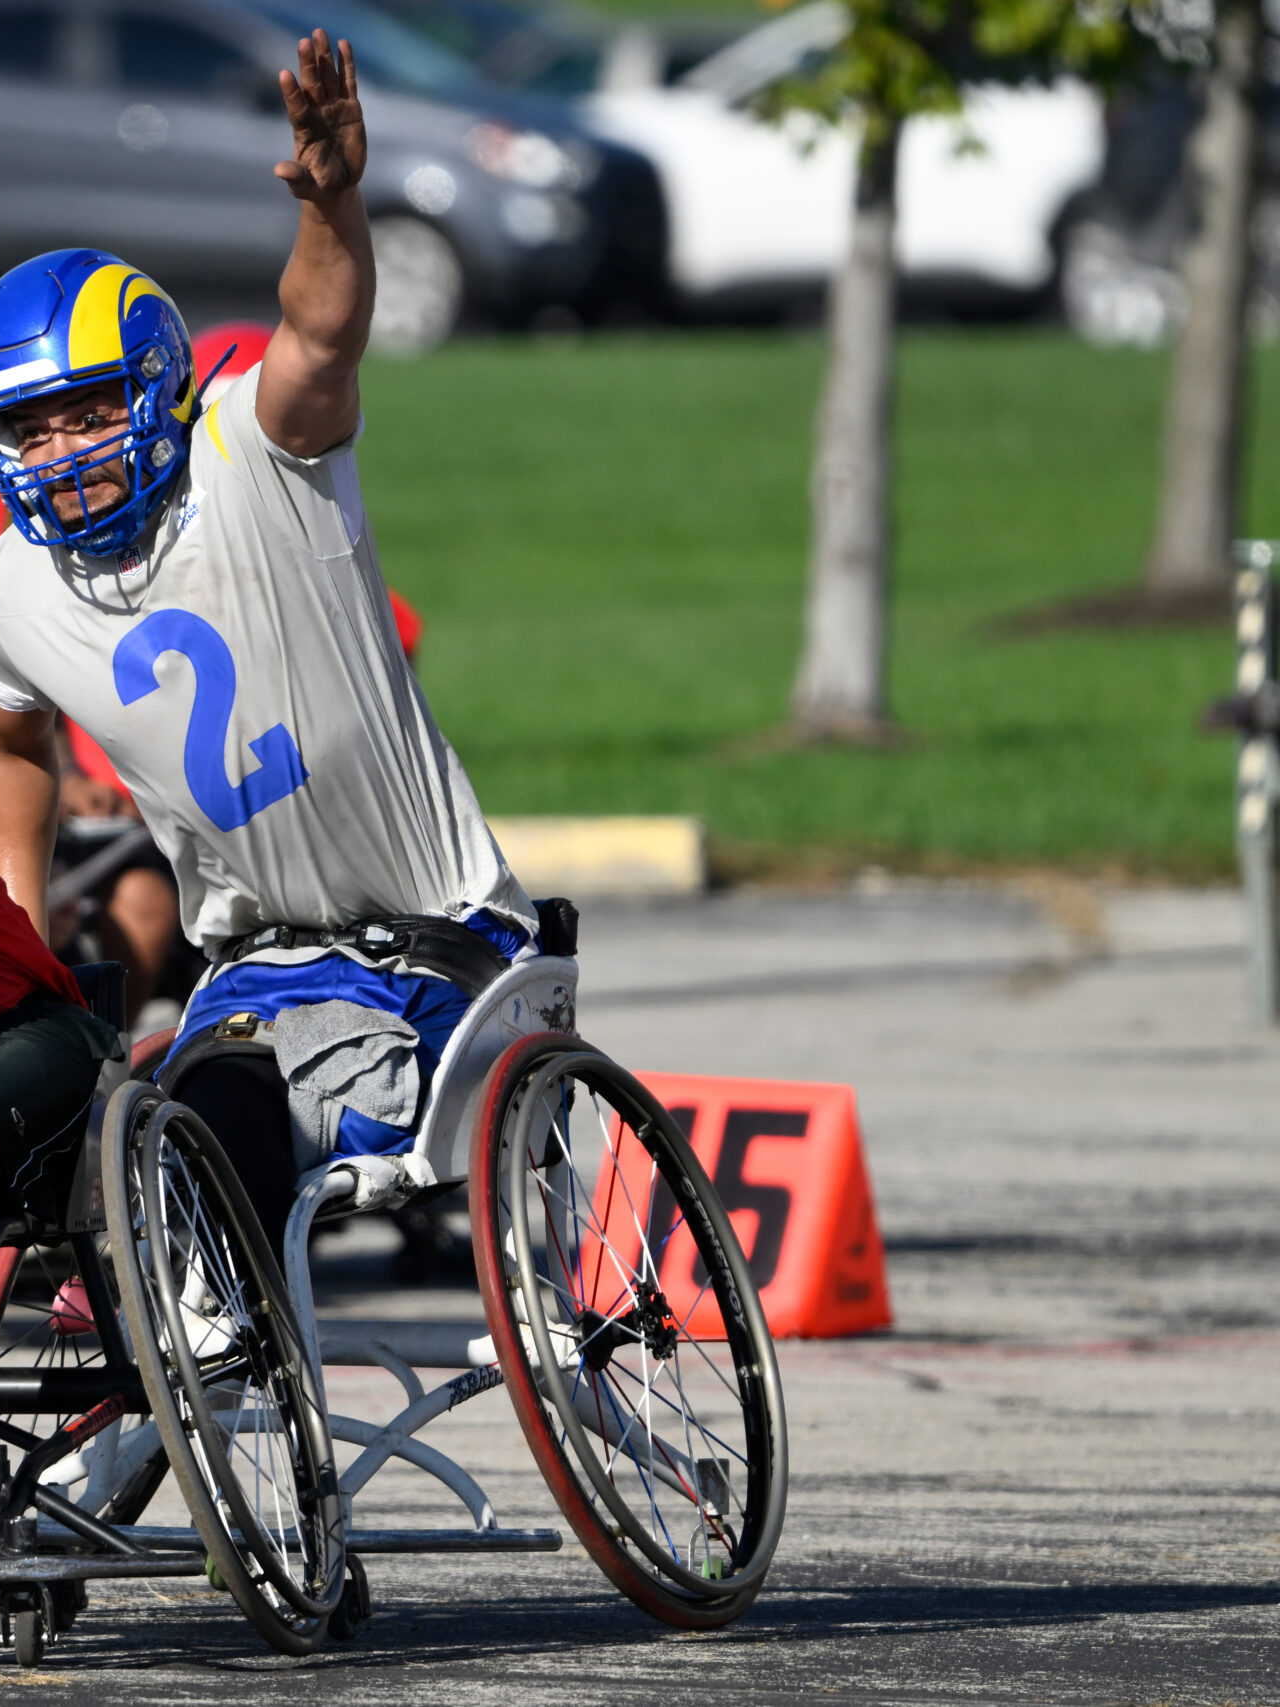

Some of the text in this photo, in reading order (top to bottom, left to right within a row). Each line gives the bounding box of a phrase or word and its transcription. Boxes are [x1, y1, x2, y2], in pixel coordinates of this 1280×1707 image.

[120, 557, 142, 574] NFL
[112, 607, 311, 833] 2
[636, 1106, 810, 1291] 15
[681, 1176, 748, 1333] SPINERGY
